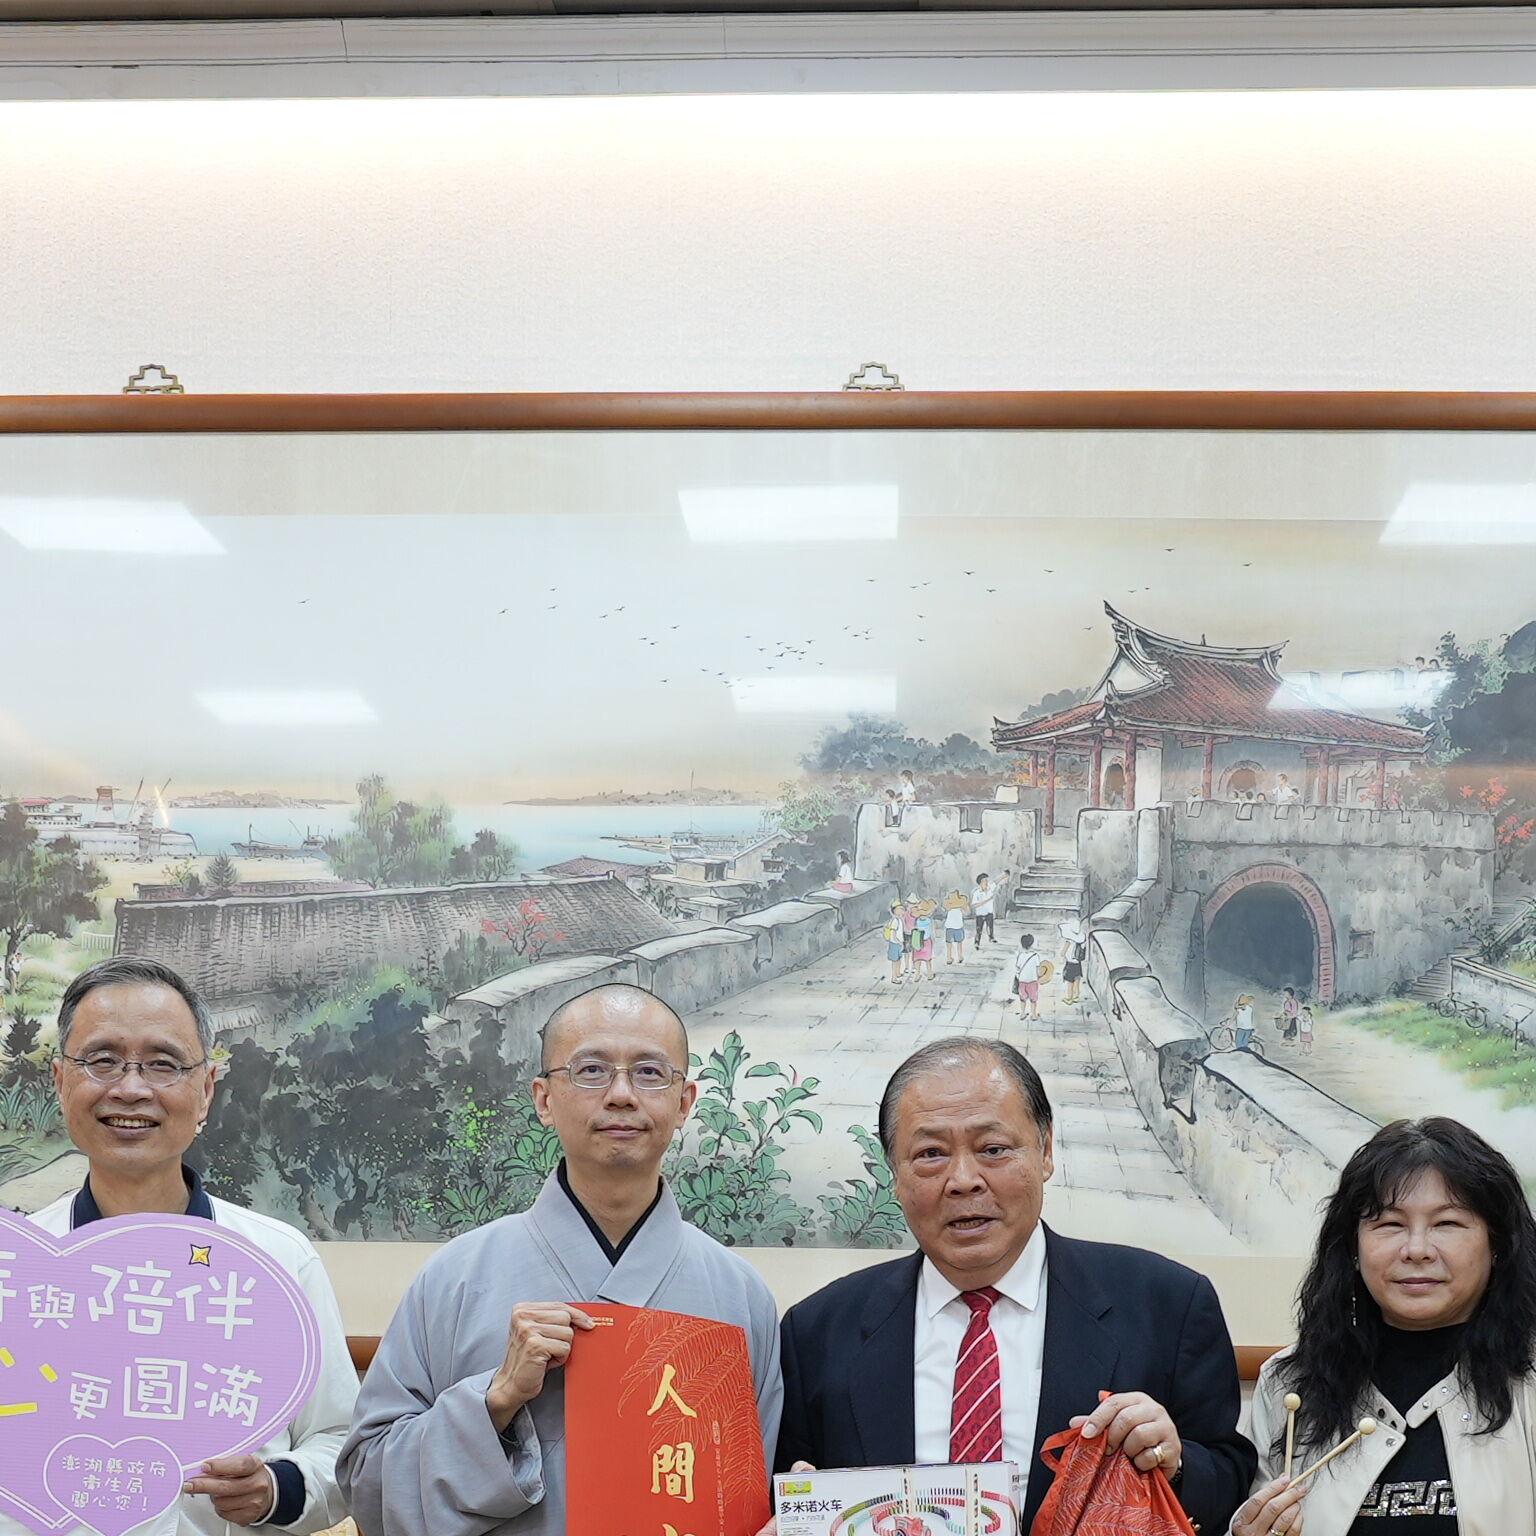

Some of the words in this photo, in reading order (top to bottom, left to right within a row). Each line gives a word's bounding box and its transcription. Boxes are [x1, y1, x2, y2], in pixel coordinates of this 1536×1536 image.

[63, 1454, 166, 1478] 澎湖縣政府
[83, 1474, 144, 1493] 衛生局
[780, 1500, 843, 1514] 多米诺火车
